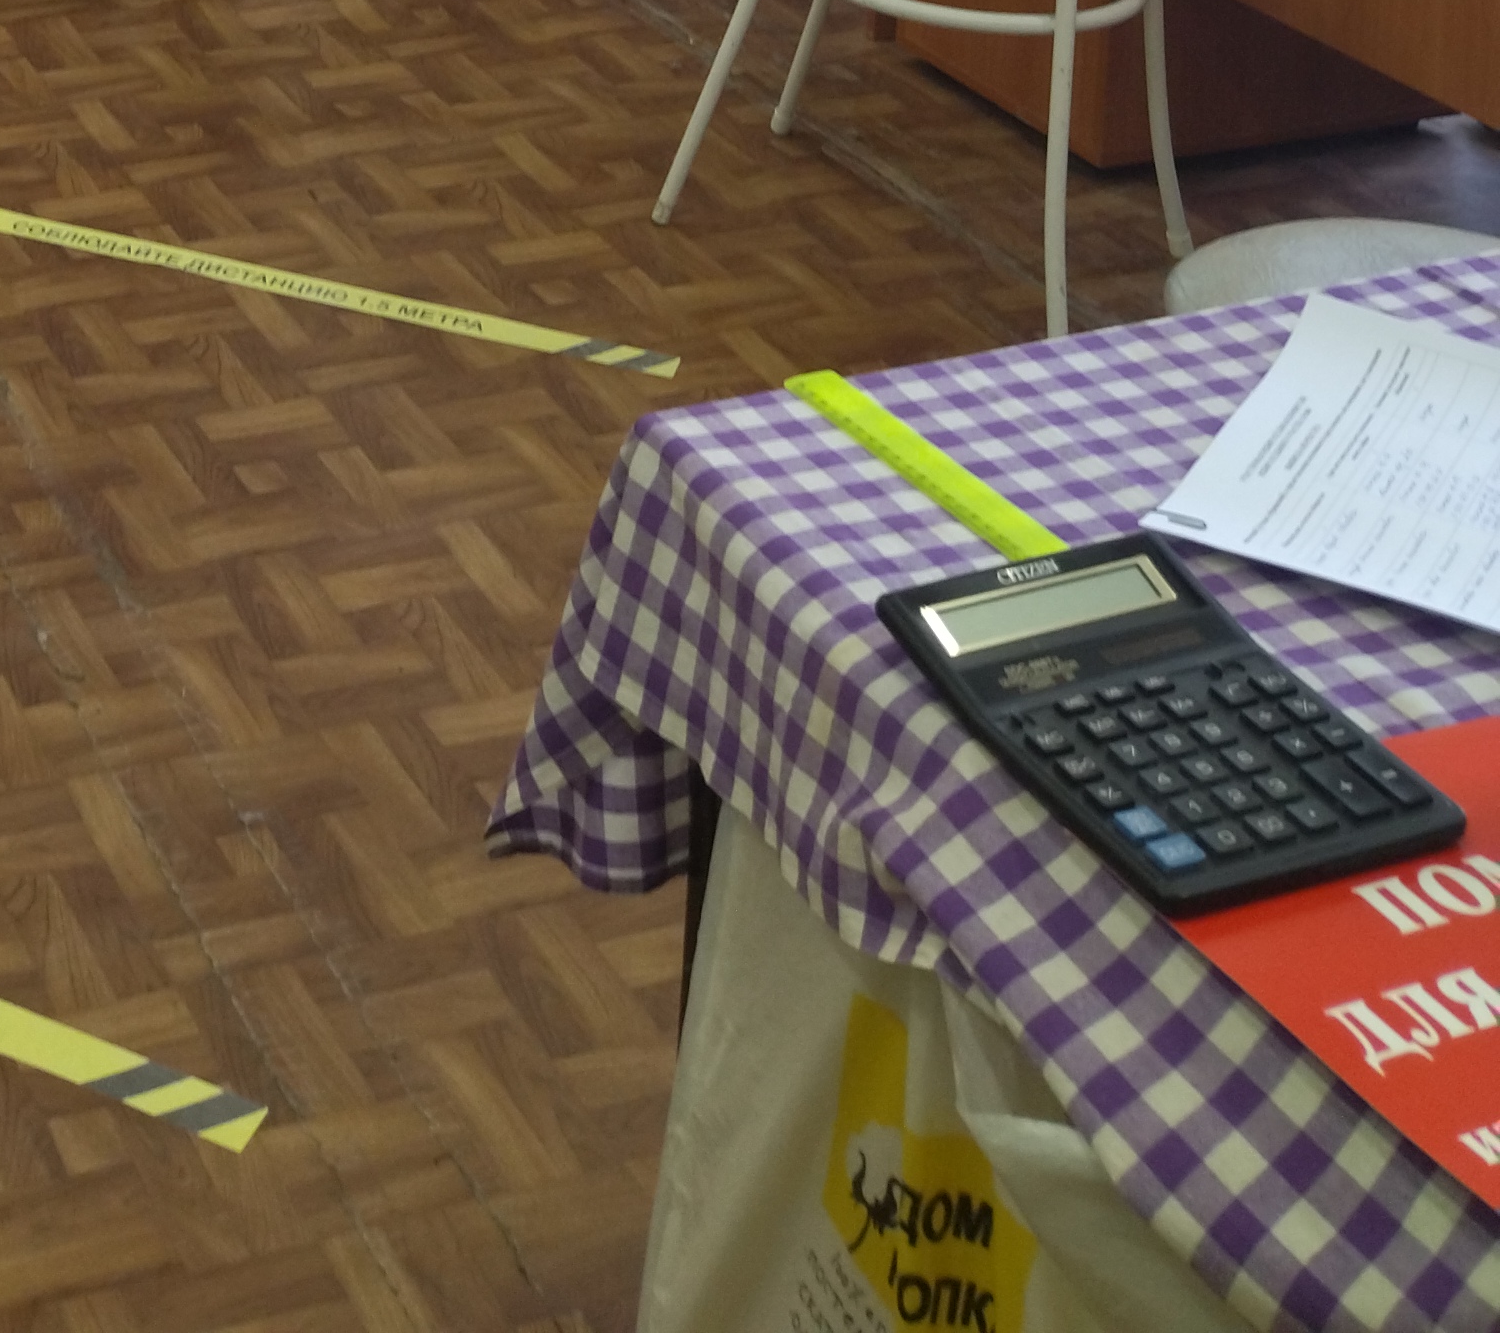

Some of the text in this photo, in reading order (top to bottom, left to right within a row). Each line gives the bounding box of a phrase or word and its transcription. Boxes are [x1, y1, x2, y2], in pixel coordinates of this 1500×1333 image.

[12, 220, 183, 267] СОБЛЮДАЙТЕ
[182, 256, 349, 303] ДИСТАНЦИЮ
[398, 305, 484, 333] МЕТРА
[996, 557, 1059, 586] CITIZEN
[1324, 966, 1500, 1079] ДЛЯ
